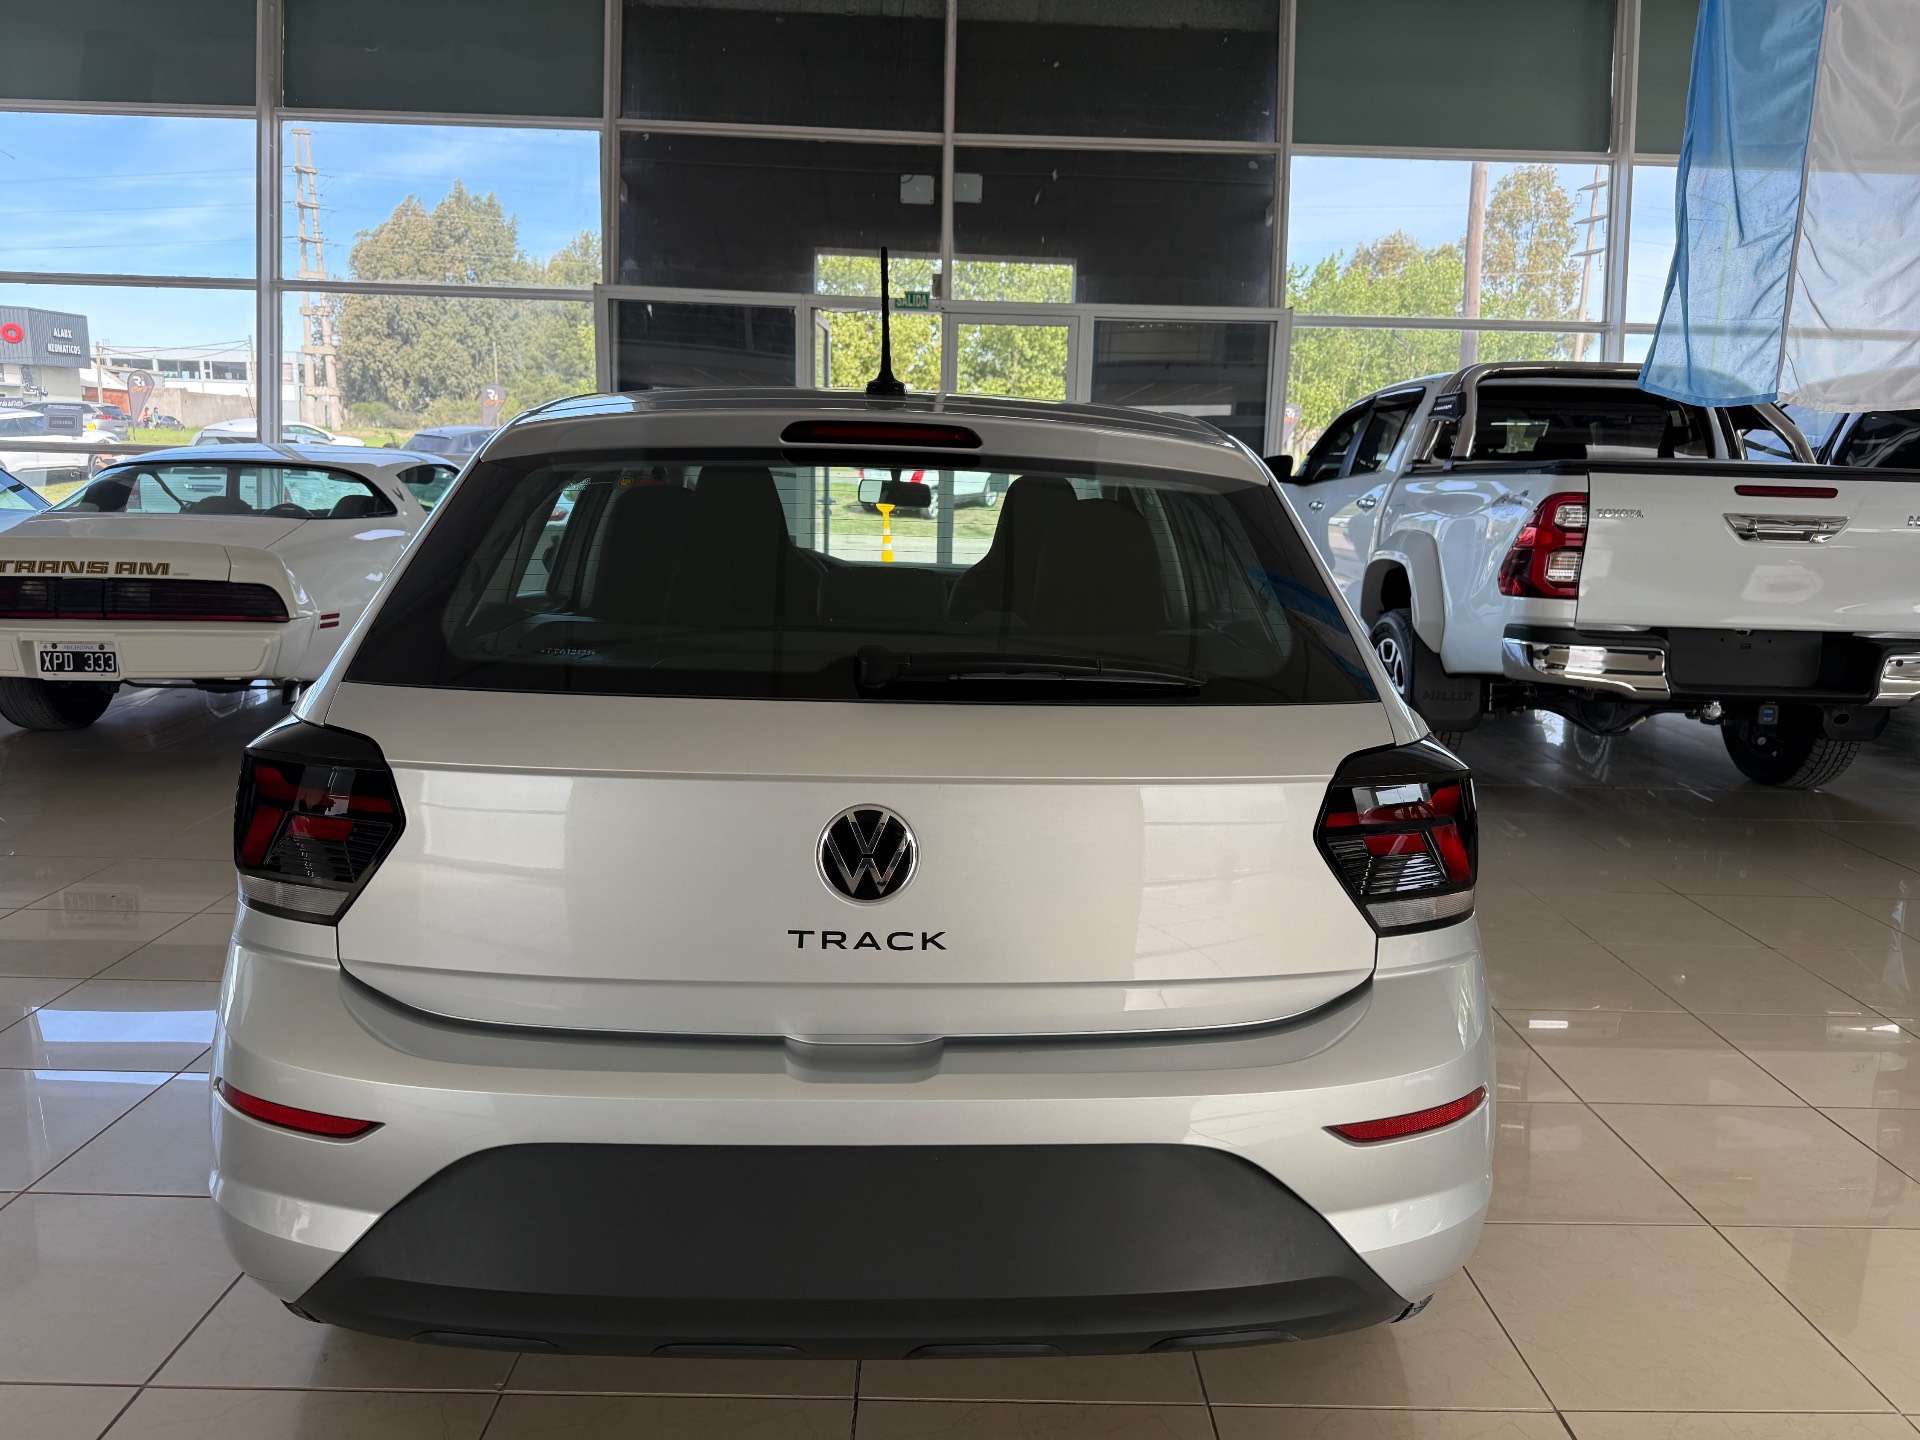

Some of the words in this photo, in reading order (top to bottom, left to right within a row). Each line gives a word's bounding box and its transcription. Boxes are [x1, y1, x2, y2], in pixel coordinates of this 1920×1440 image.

[896, 294, 927, 307] SALIDA
[53, 328, 72, 338] ALAUX
[47, 343, 81, 355] NEUMATICOS
[1596, 508, 1644, 518] TOYOTA
[0, 560, 109, 574] TRANS
[114, 561, 170, 576] AM
[43, 652, 74, 671] XPD
[84, 653, 115, 672] 333
[787, 930, 947, 951] TRACK
